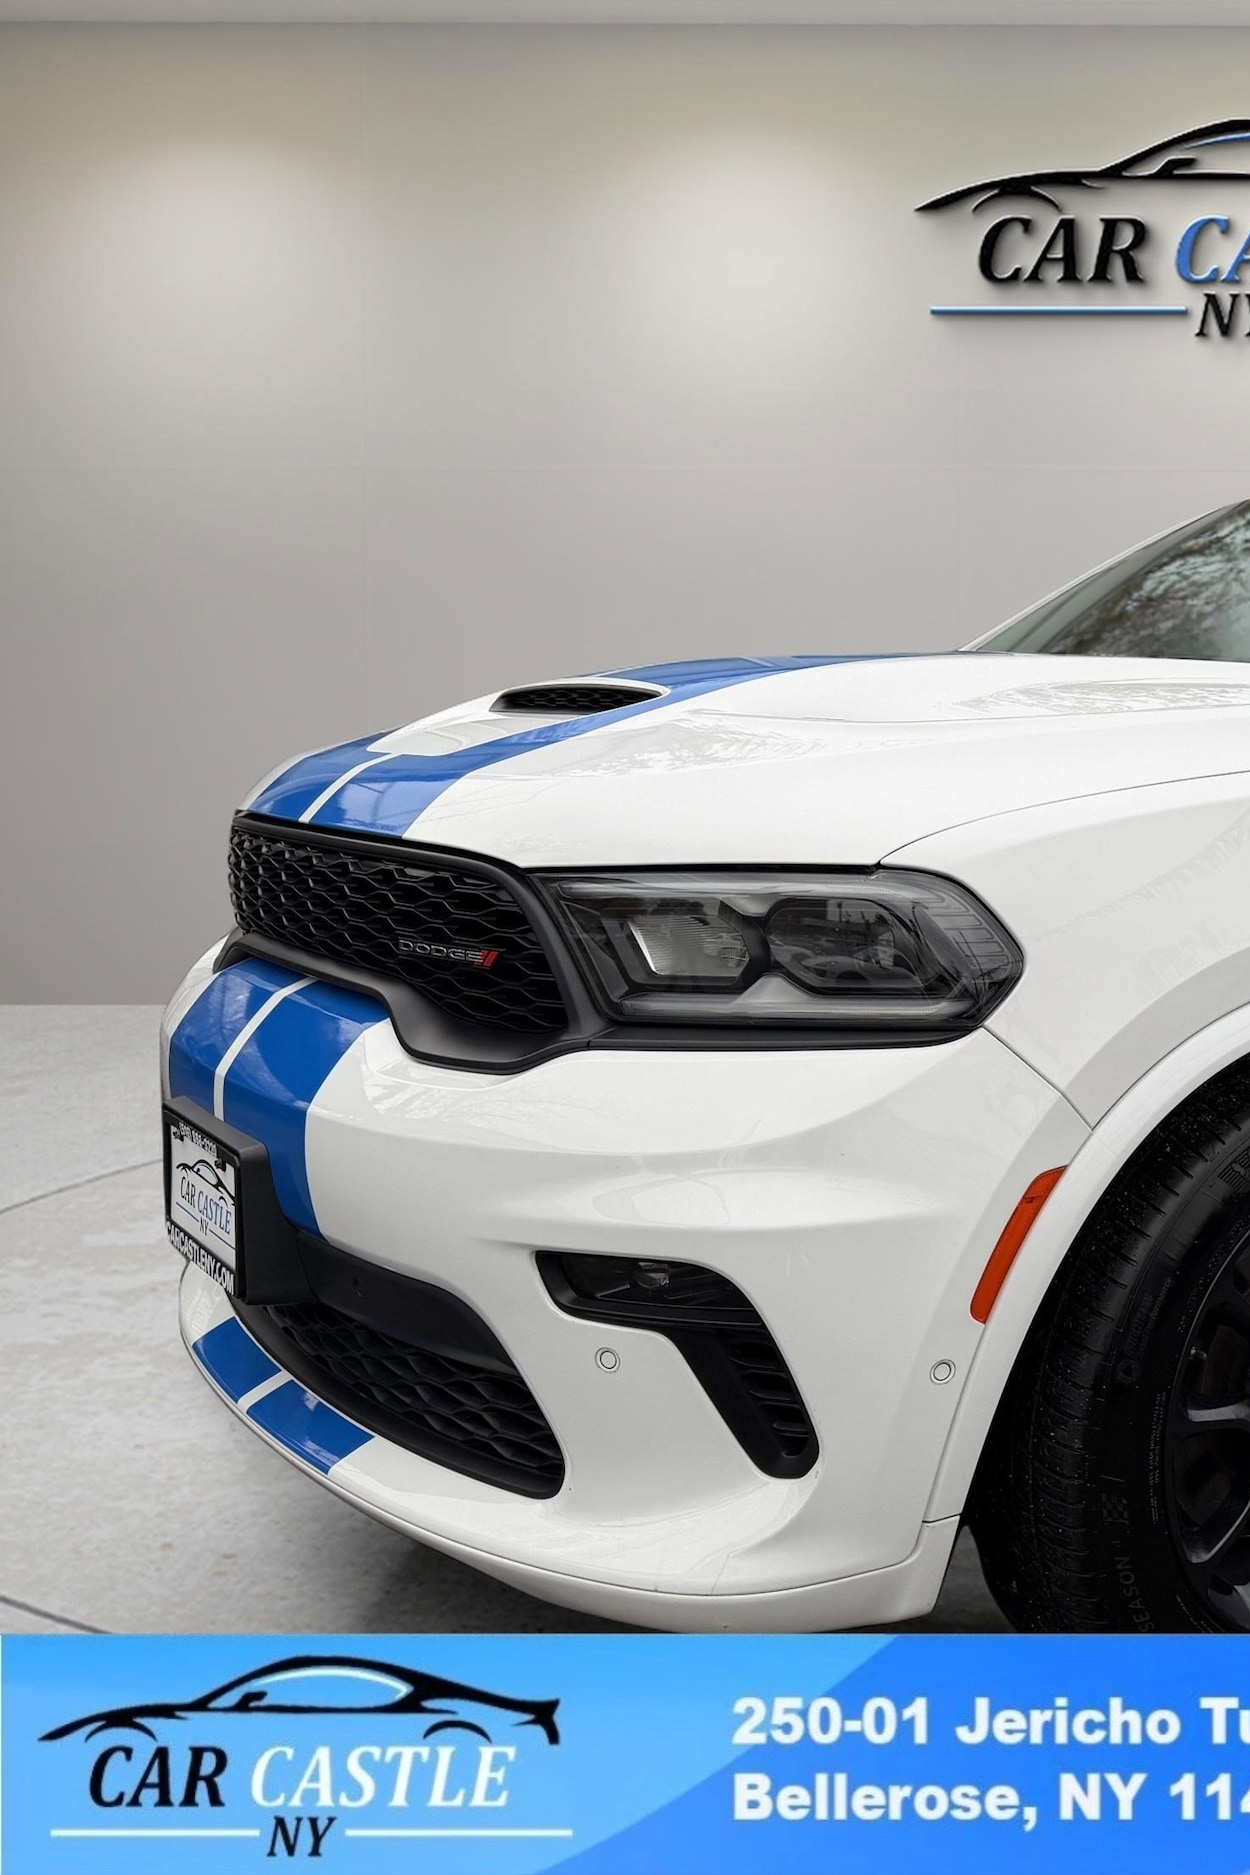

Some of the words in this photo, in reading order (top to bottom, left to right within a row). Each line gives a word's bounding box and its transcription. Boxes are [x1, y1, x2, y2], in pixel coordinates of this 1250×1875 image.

[978, 214, 1149, 284] CAR
[399, 939, 484, 963] DODGE
[180, 1175, 196, 1208] CAR
[197, 1189, 232, 1235] CASTLE
[199, 1218, 210, 1237] NY
[166, 1220, 235, 1296] CARCASTLENY.COM
[1113, 1555, 1156, 1633] SEASON
